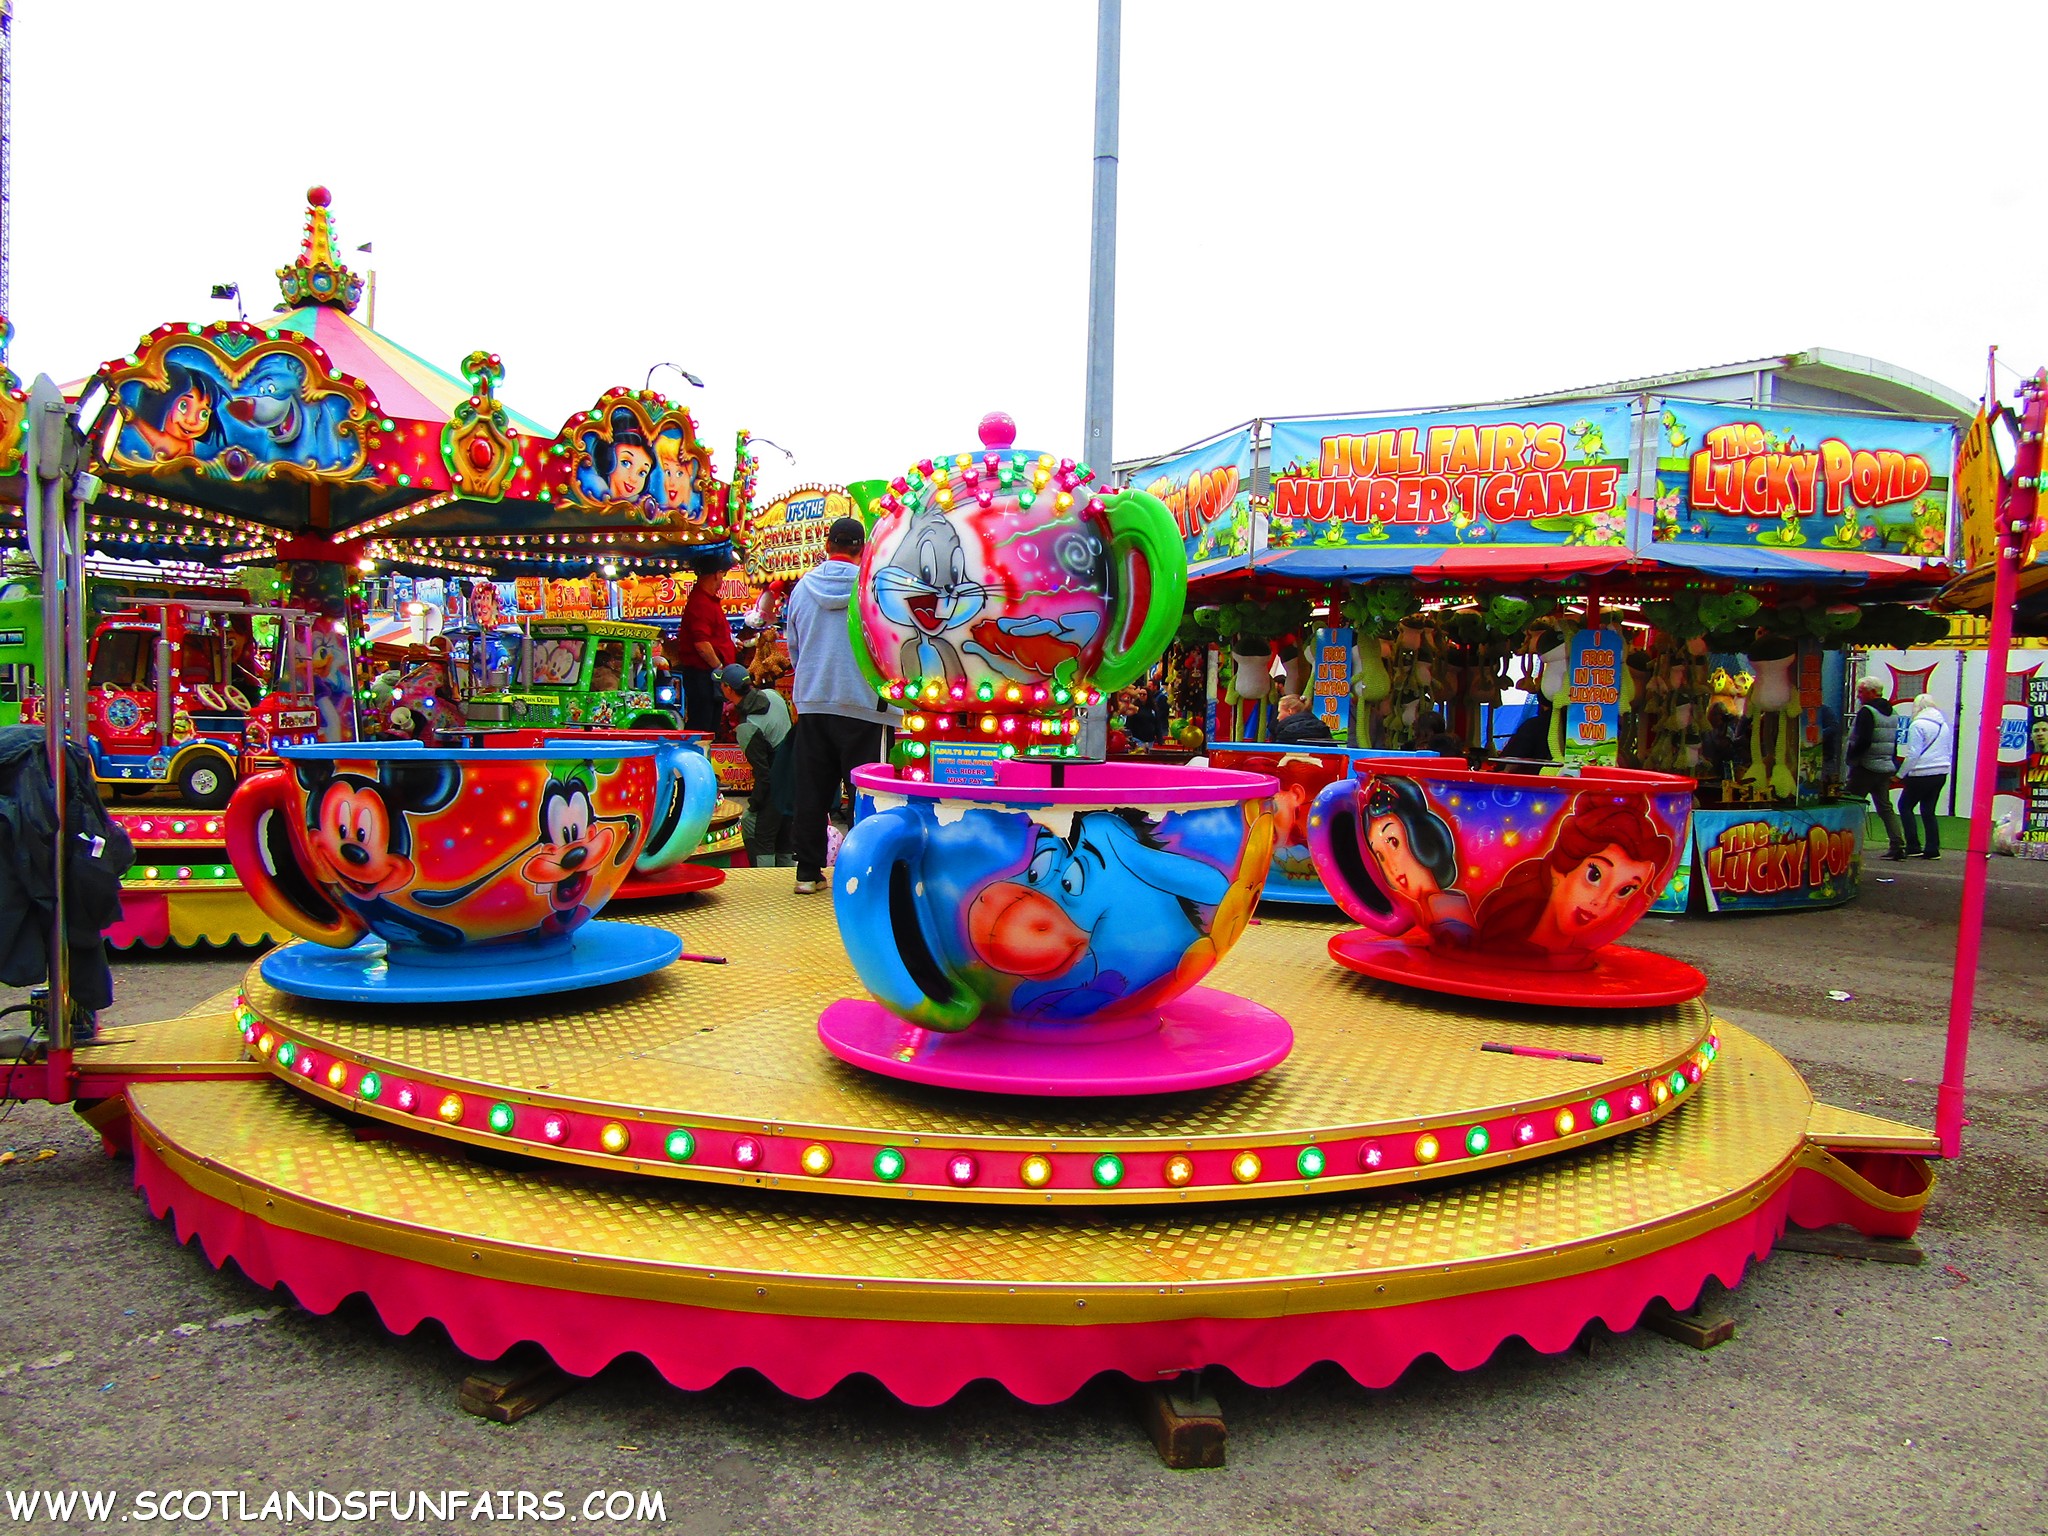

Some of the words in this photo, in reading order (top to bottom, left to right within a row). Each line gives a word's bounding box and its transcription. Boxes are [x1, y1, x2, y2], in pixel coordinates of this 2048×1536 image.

[1093, 428, 1101, 438] 3
[1321, 428, 1424, 478] HULL
[1427, 422, 1566, 475] FAIR'S
[1274, 477, 1452, 524] NUMBER
[1453, 473, 1479, 522] 1
[1480, 466, 1620, 524] GAME
[806, 499, 824, 519] THE
[763, 523, 802, 548] PRIZE
[804, 517, 830, 544] EVE
[765, 547, 801, 572] TIME
[556, 584, 564, 608] 3
[657, 578, 676, 603] 3
[623, 605, 655, 618] EVERY
[657, 604, 685, 616] PLAY
[596, 626, 652, 638] MICKEY
[1323, 647, 1346, 662] FROG
[1581, 649, 1614, 667] FROG
[1318, 663, 1329, 679] IN
[1330, 664, 1347, 680] THE
[1574, 667, 1589, 685] IN
[1591, 668, 1615, 686] THE
[1569, 686, 1618, 704] LILYPAD
[1325, 697, 1337, 712] TO
[1584, 704, 1602, 722] TO
[1321, 713, 1340, 731] WIN
[1578, 722, 1606, 740] WIN
[722, 768, 751, 780] WIN
